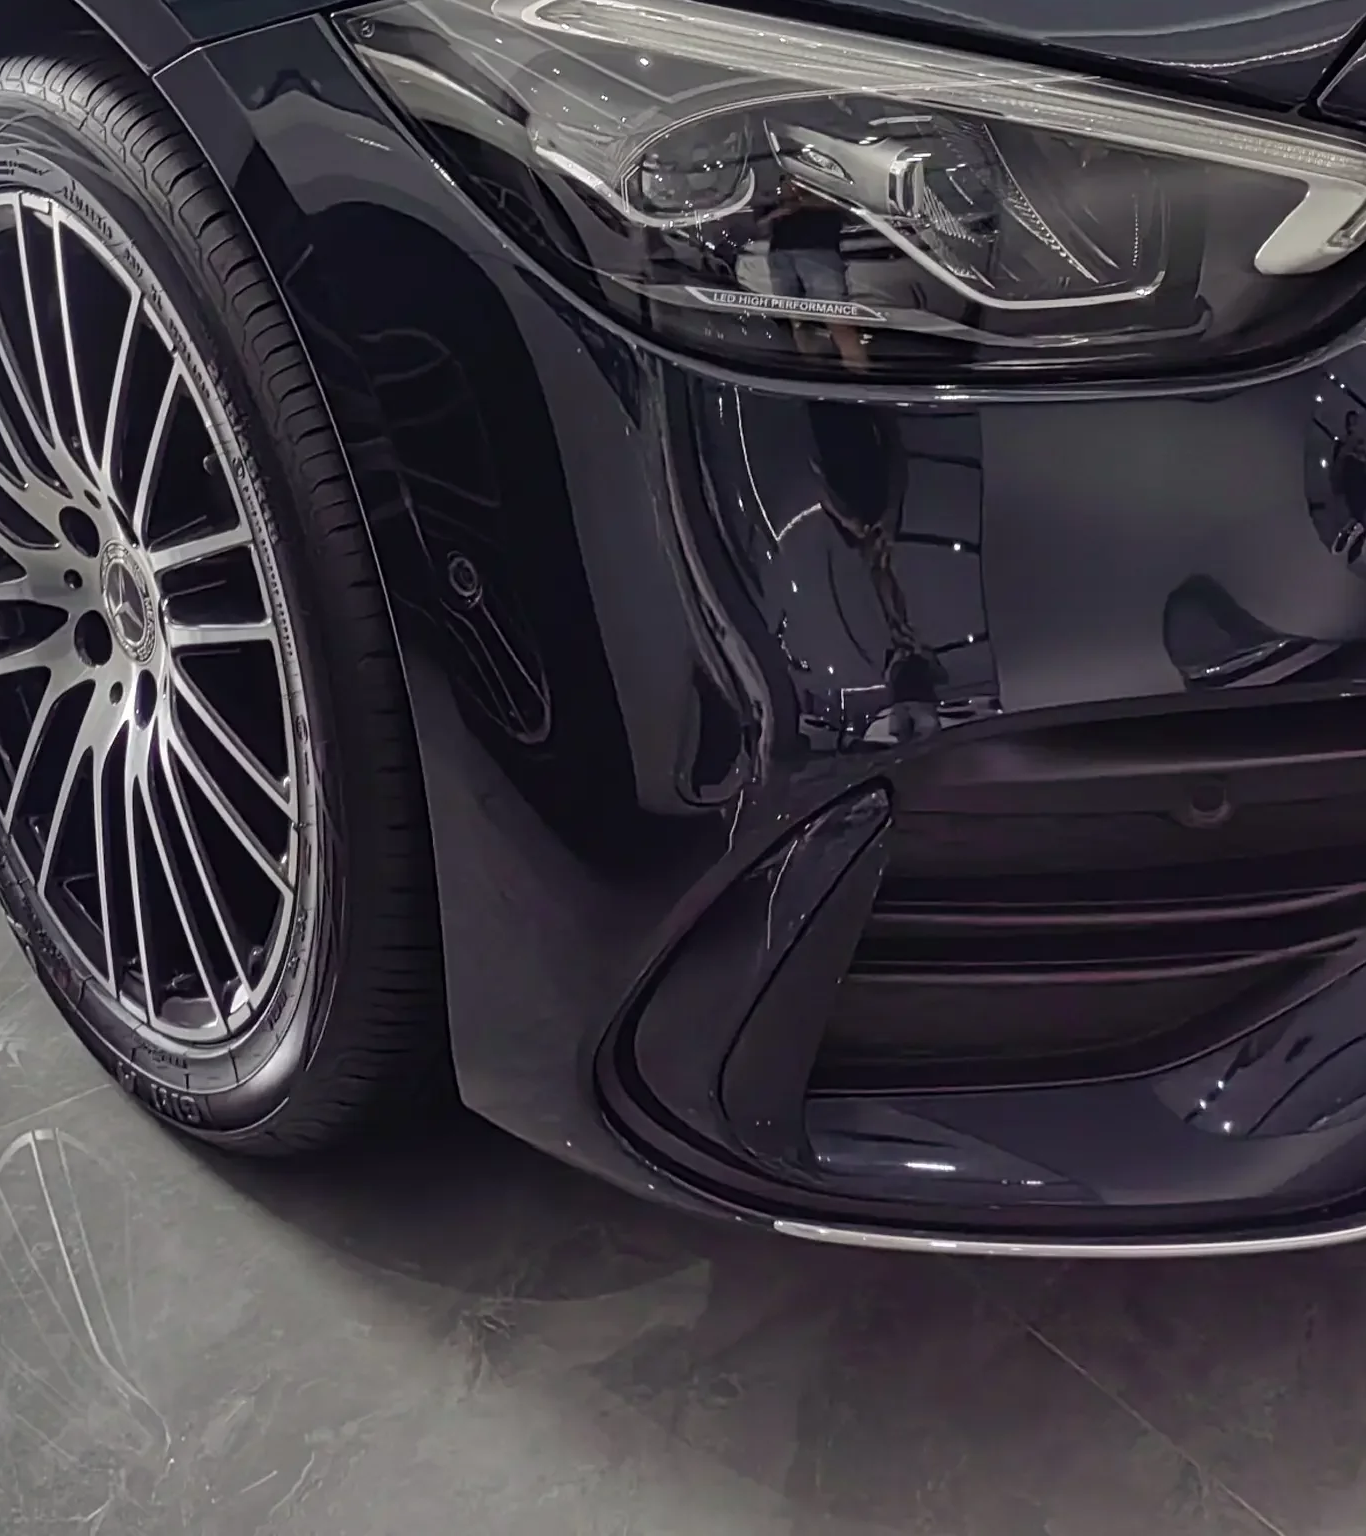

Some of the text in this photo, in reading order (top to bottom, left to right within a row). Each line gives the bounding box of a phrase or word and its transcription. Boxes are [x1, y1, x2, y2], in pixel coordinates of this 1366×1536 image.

[713, 292, 858, 316] LED HIGH PERFORMANCE
